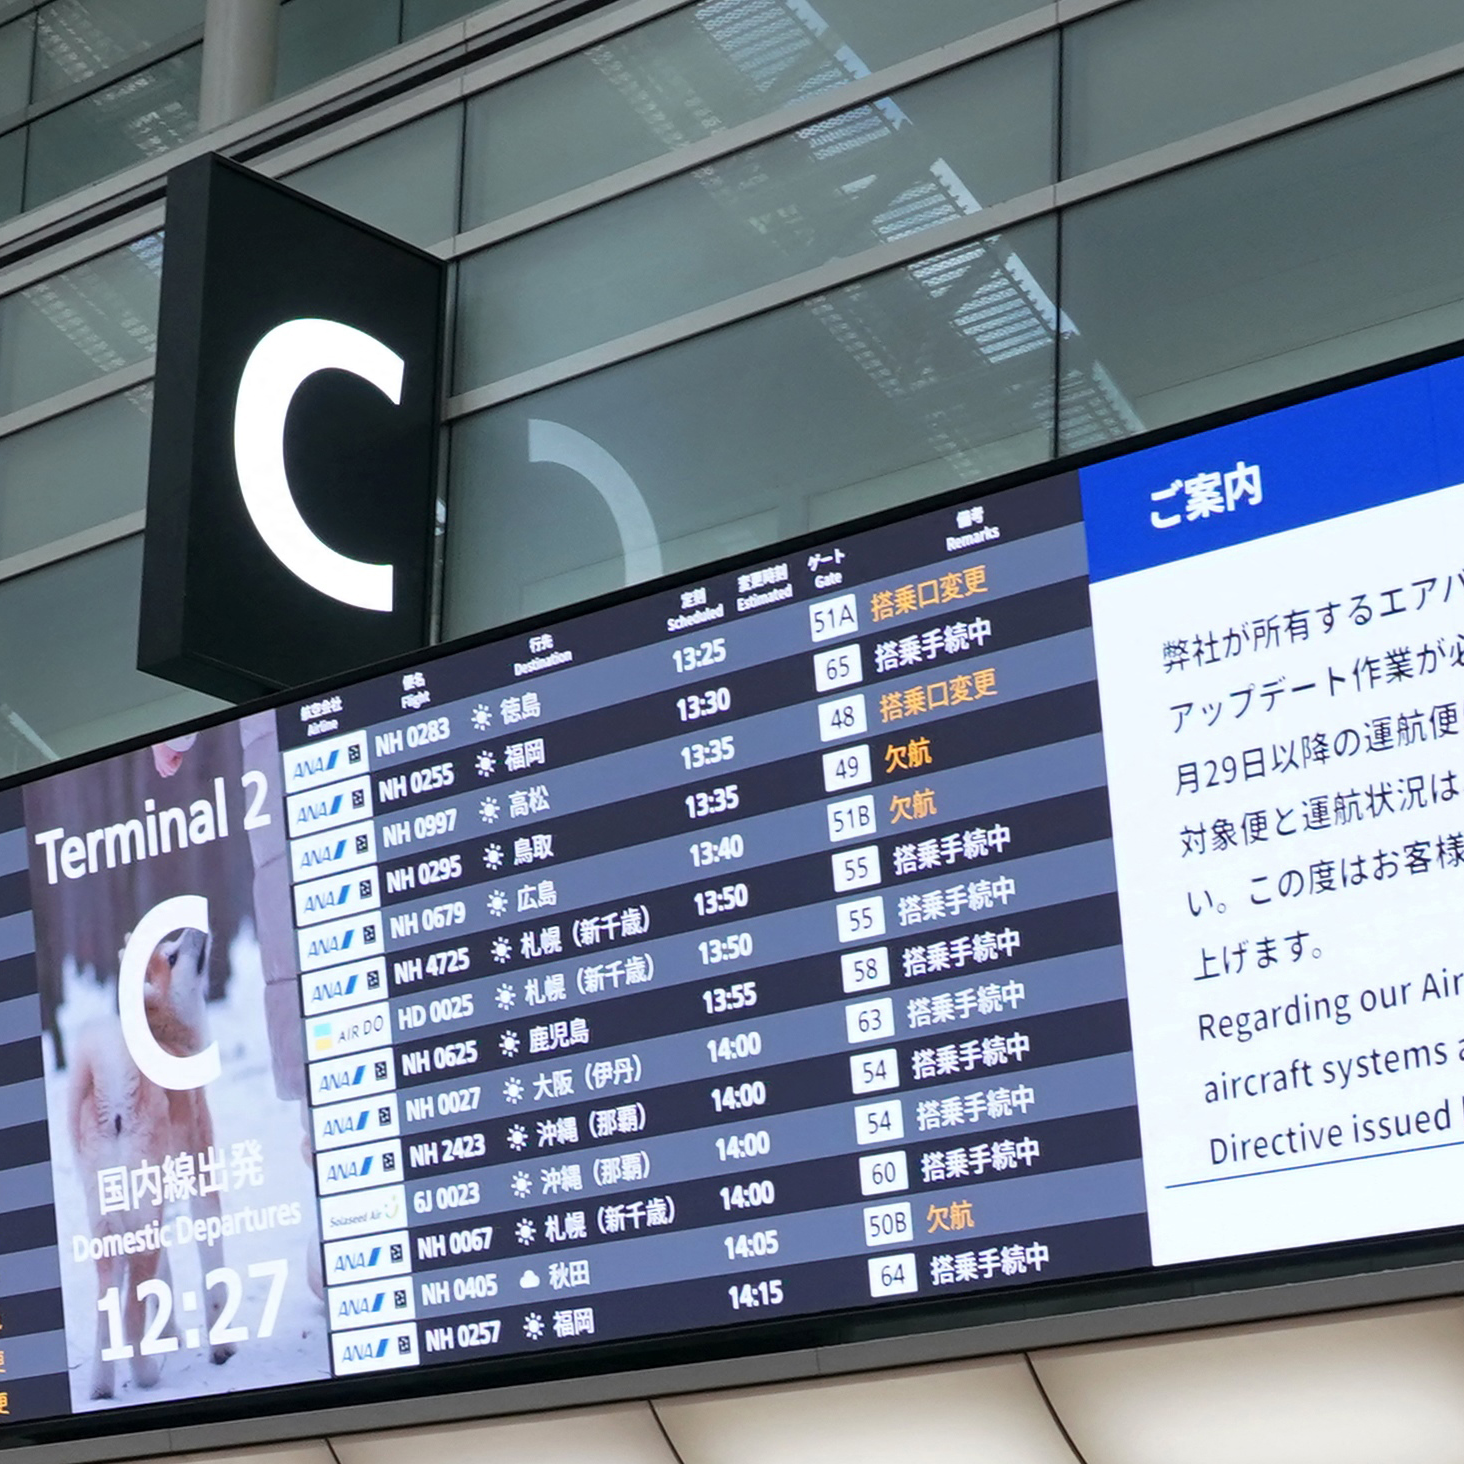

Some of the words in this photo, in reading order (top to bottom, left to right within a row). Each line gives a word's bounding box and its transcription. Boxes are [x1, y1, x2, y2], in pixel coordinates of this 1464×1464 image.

[235, 319, 404, 611] C
[1152, 462, 1261, 528] ご案内
[946, 524, 1000, 551] Remarks
[292, 757, 326, 780] ANA
[376, 730, 403, 756] NH
[407, 717, 450, 747] 0283
[501, 693, 540, 724] 徳島
[673, 638, 726, 672] 13:25
[814, 603, 855, 633] 51A
[871, 565, 988, 622] 搭乗口変更
[35, 777, 228, 884] Terminal
[242, 770, 271, 831] 2
[387, 867, 414, 892] NH
[419, 855, 461, 884] 0295
[515, 835, 553, 865] 鳥取
[686, 785, 738, 818] 13:35
[835, 756, 859, 778] 49
[886, 737, 931, 772] 欠航
[118, 894, 223, 1092] C
[363, 1015, 384, 1037] DO
[398, 1005, 426, 1030] HD
[430, 994, 473, 1022] 0025
[699, 933, 752, 964] 13:50
[849, 907, 873, 932] 55
[898, 876, 1015, 926] 搭乗手続中
[1193, 930, 1324, 981] 上げます。
[323, 1117, 355, 1139] ANA
[406, 1097, 434, 1121] NH
[438, 1087, 480, 1115] 0027
[707, 1032, 761, 1062] 14:00
[858, 1008, 882, 1033] 63
[907, 980, 1024, 1028] 搭乗手続中
[1200, 994, 1350, 1042] Regarding
[1361, 983, 1410, 1011] our
[1206, 1059, 1312, 1103] aircraft
[1324, 1043, 1446, 1089] systems
[96, 1138, 265, 1216] 国内線出発
[1211, 1123, 1341, 1164] Directive
[1354, 1099, 1450, 1147] issued
[72, 1225, 170, 1264] Domestic
[176, 1199, 302, 1248] Departures
[422, 1281, 450, 1305] NH
[454, 1274, 497, 1300] 0405
[549, 1260, 589, 1289] 秋田
[725, 1230, 778, 1259] 14:05
[870, 1211, 907, 1238] 50B
[927, 1200, 974, 1233] 欠航
[96, 1259, 289, 1363] 12:27
[342, 1339, 375, 1361] ANA
[426, 1328, 453, 1351] NH
[458, 1321, 500, 1347] 0257
[554, 1308, 594, 1337] 福岡
[729, 1280, 783, 1309] 14:15
[881, 1263, 905, 1287] 64
[931, 1242, 1048, 1285] 搭乗手続中
